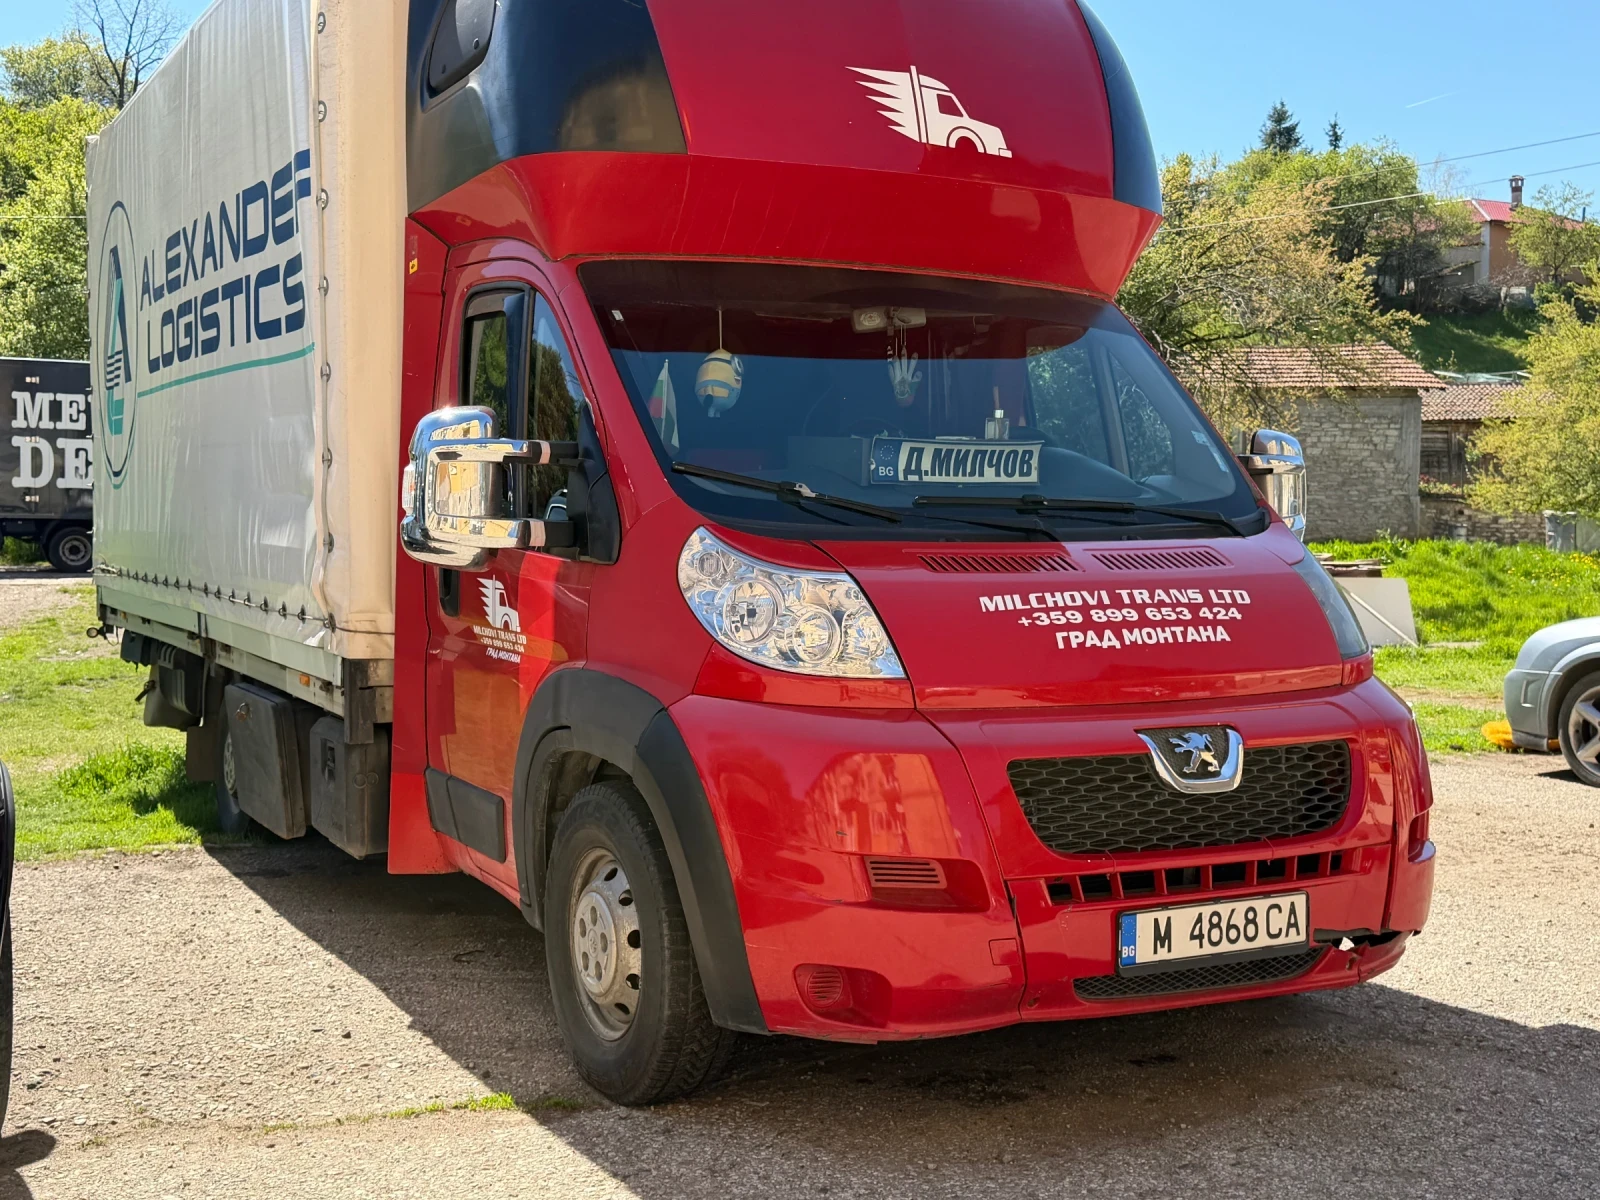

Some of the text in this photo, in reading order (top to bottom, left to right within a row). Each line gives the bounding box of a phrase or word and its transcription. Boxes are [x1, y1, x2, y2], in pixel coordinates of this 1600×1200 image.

[147, 251, 306, 374] LOGISTICS
[11, 391, 92, 431] ME
[878, 466, 894, 476] BG
[902, 446, 1034, 481] Д.МИЛЧОВ
[979, 589, 1251, 612] MILCHOVI TRANS LTD
[1017, 607, 1242, 627] +359 899 653 424
[497, 630, 517, 643] TRANS
[516, 634, 527, 645] LTD
[1055, 625, 1231, 650] ГРАД МОНТАНА
[1189, 906, 1259, 949] 4868
[1121, 945, 1136, 958] BG
